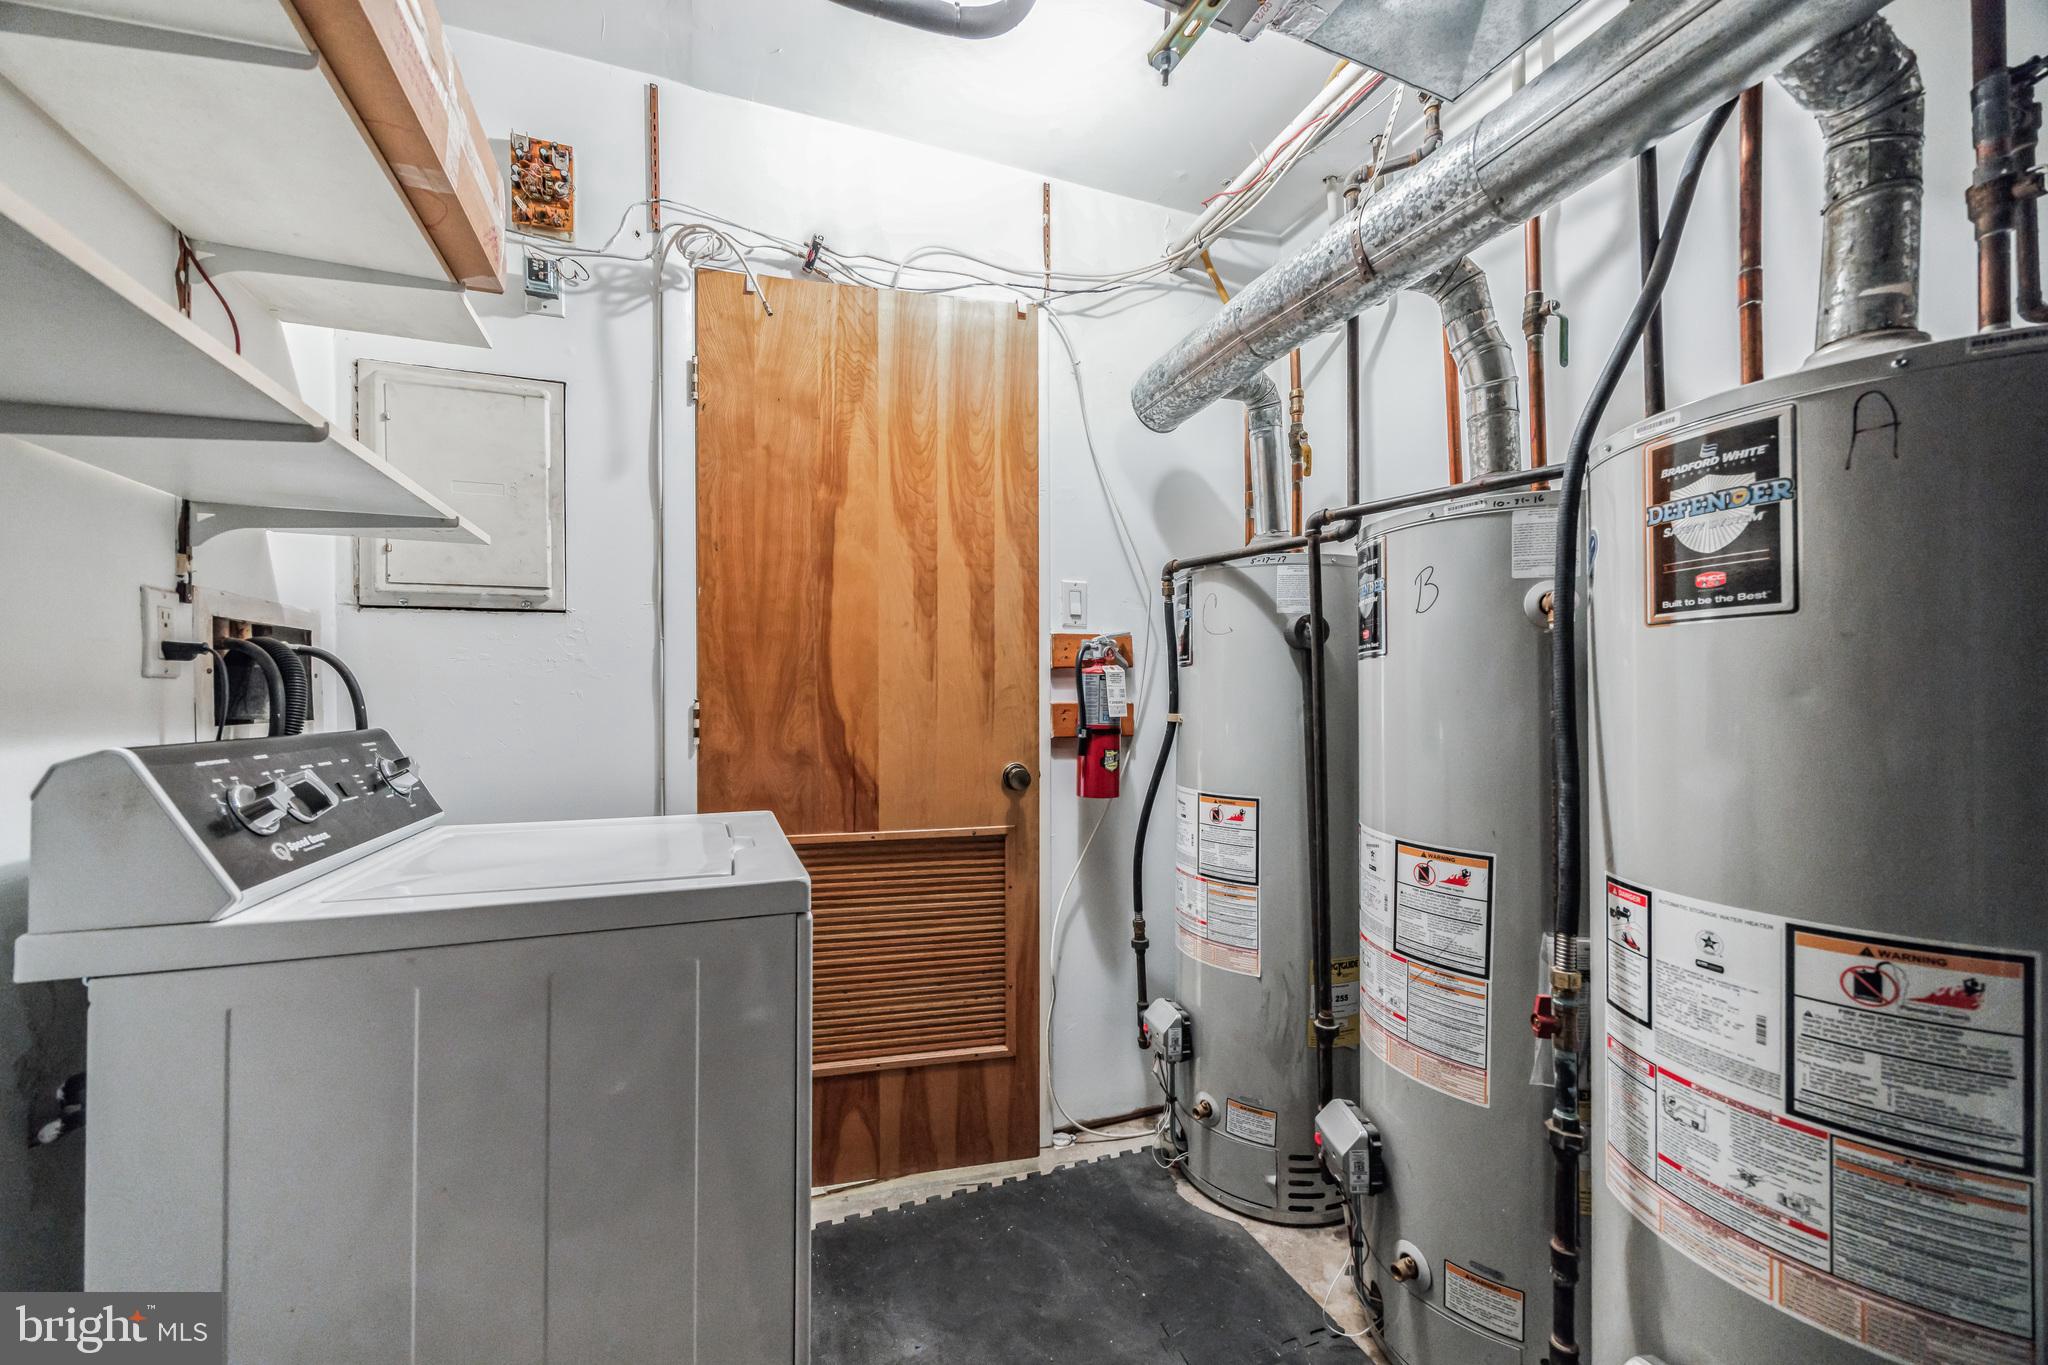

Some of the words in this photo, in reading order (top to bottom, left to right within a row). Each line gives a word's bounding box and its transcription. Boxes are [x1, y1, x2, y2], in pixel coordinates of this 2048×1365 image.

[1846, 390, 1900, 470] A
[1660, 455, 1720, 480] BRADFORD
[1721, 444, 1770, 464] WHITE
[1647, 477, 1796, 528] DEFENDER
[1414, 565, 1440, 615] B
[1661, 600, 1683, 609] Built
[1684, 599, 1695, 607] to
[1697, 596, 1712, 605] be
[1714, 593, 1734, 603] the
[1736, 589, 1767, 601] Best
[1202, 592, 1234, 636] C
[1427, 852, 1456, 863] WARNING
[1719, 913, 1744, 925] WATER
[1744, 919, 1775, 931] HEATER
[1877, 948, 1949, 968] WARNING
